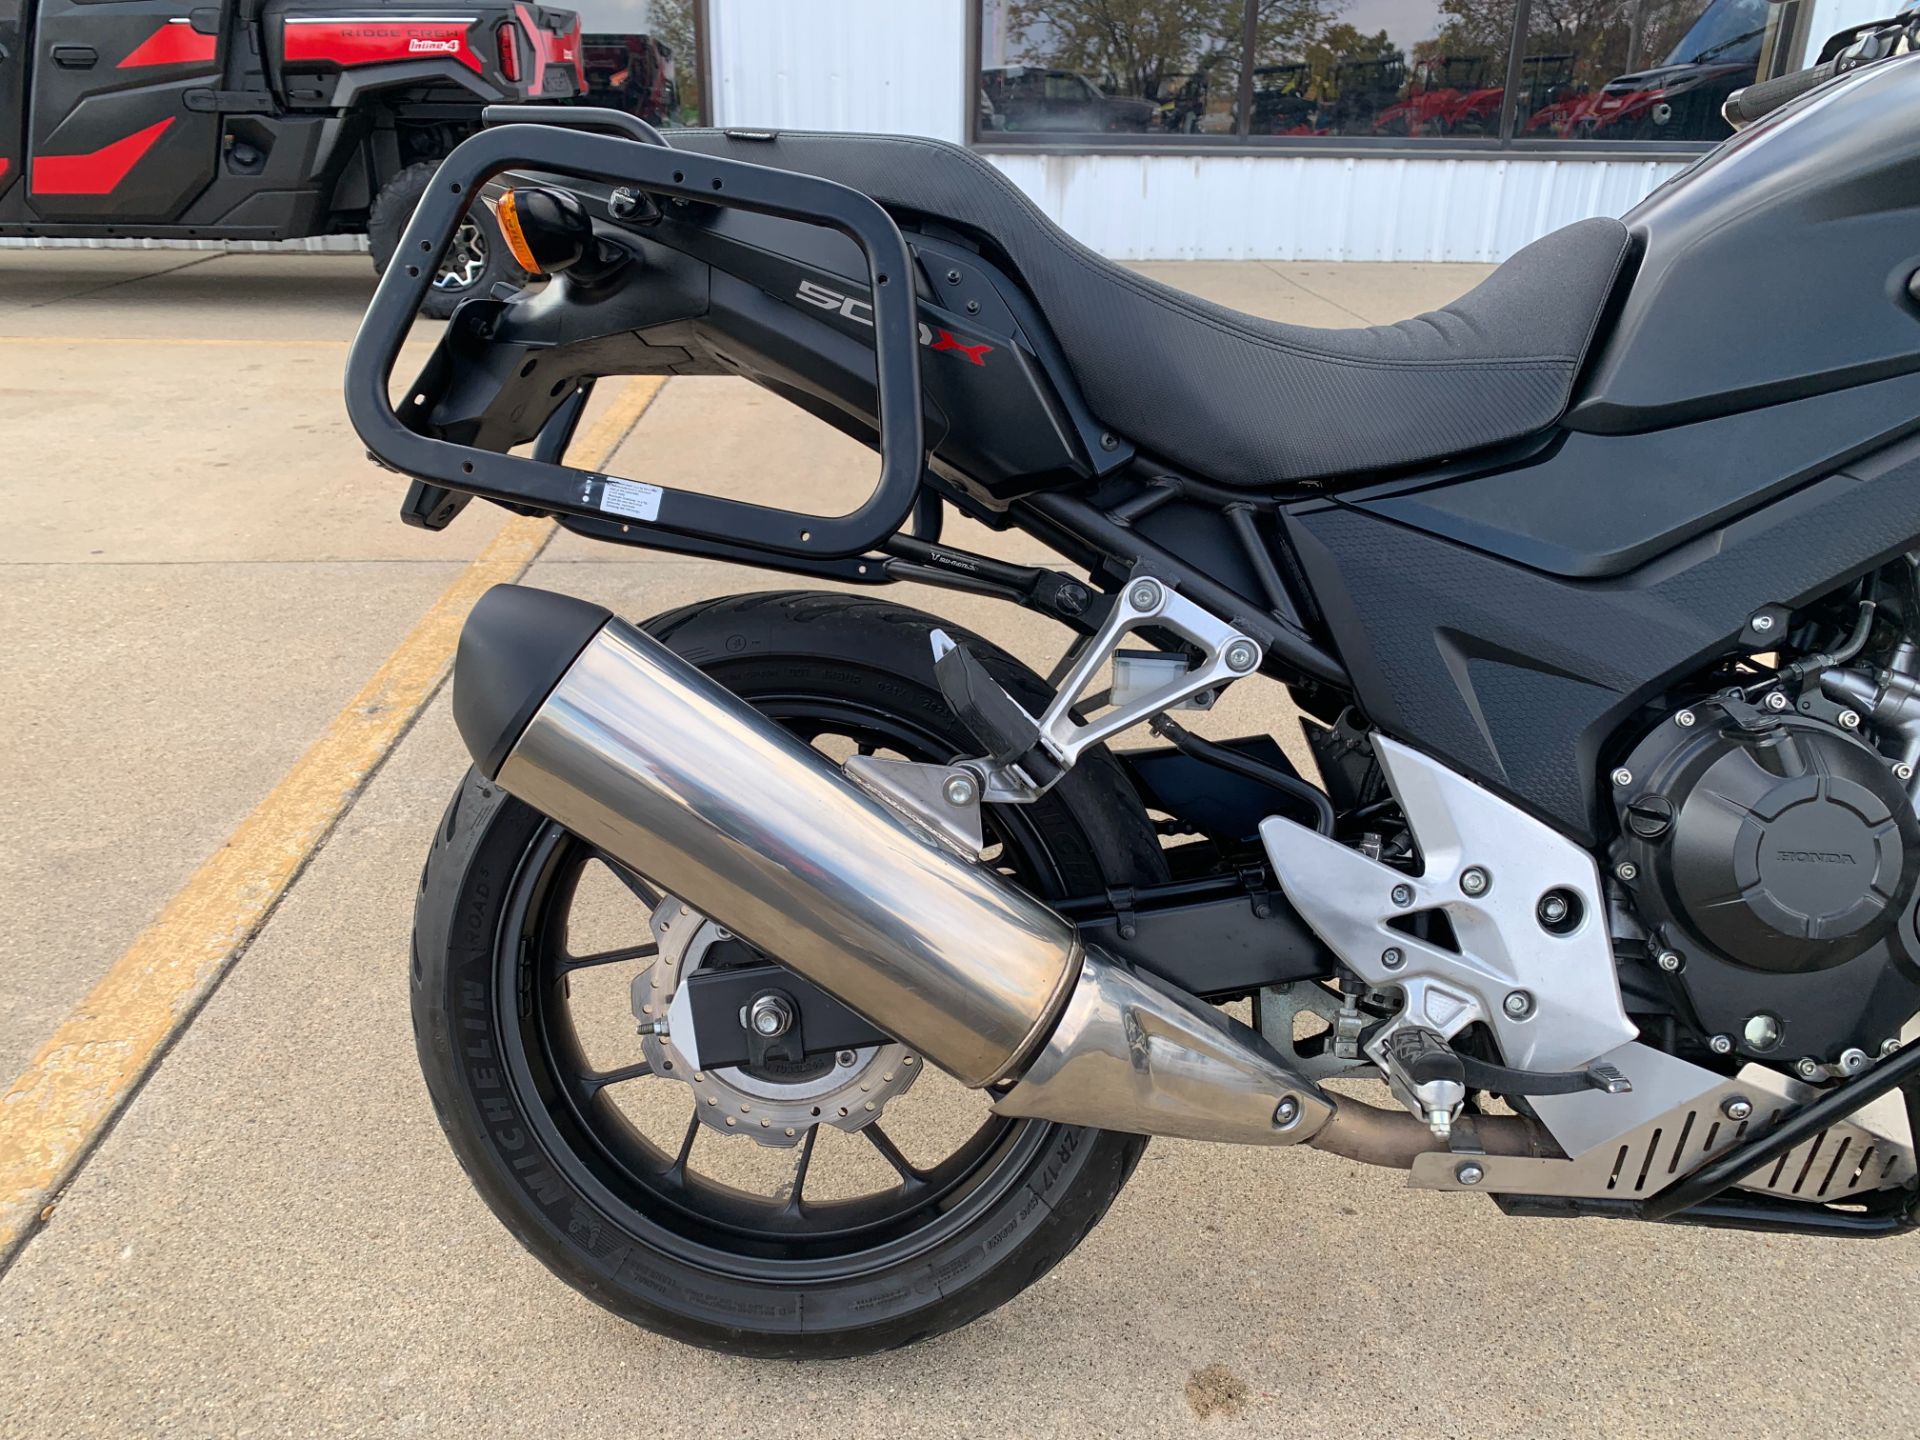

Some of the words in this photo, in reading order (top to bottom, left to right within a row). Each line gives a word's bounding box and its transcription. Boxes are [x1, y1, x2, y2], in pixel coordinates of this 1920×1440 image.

[341, 29, 400, 37] RIDGE
[407, 29, 459, 37] CREW
[1777, 850, 1856, 865] HONDA
[459, 978, 567, 1208] MICHELIN
